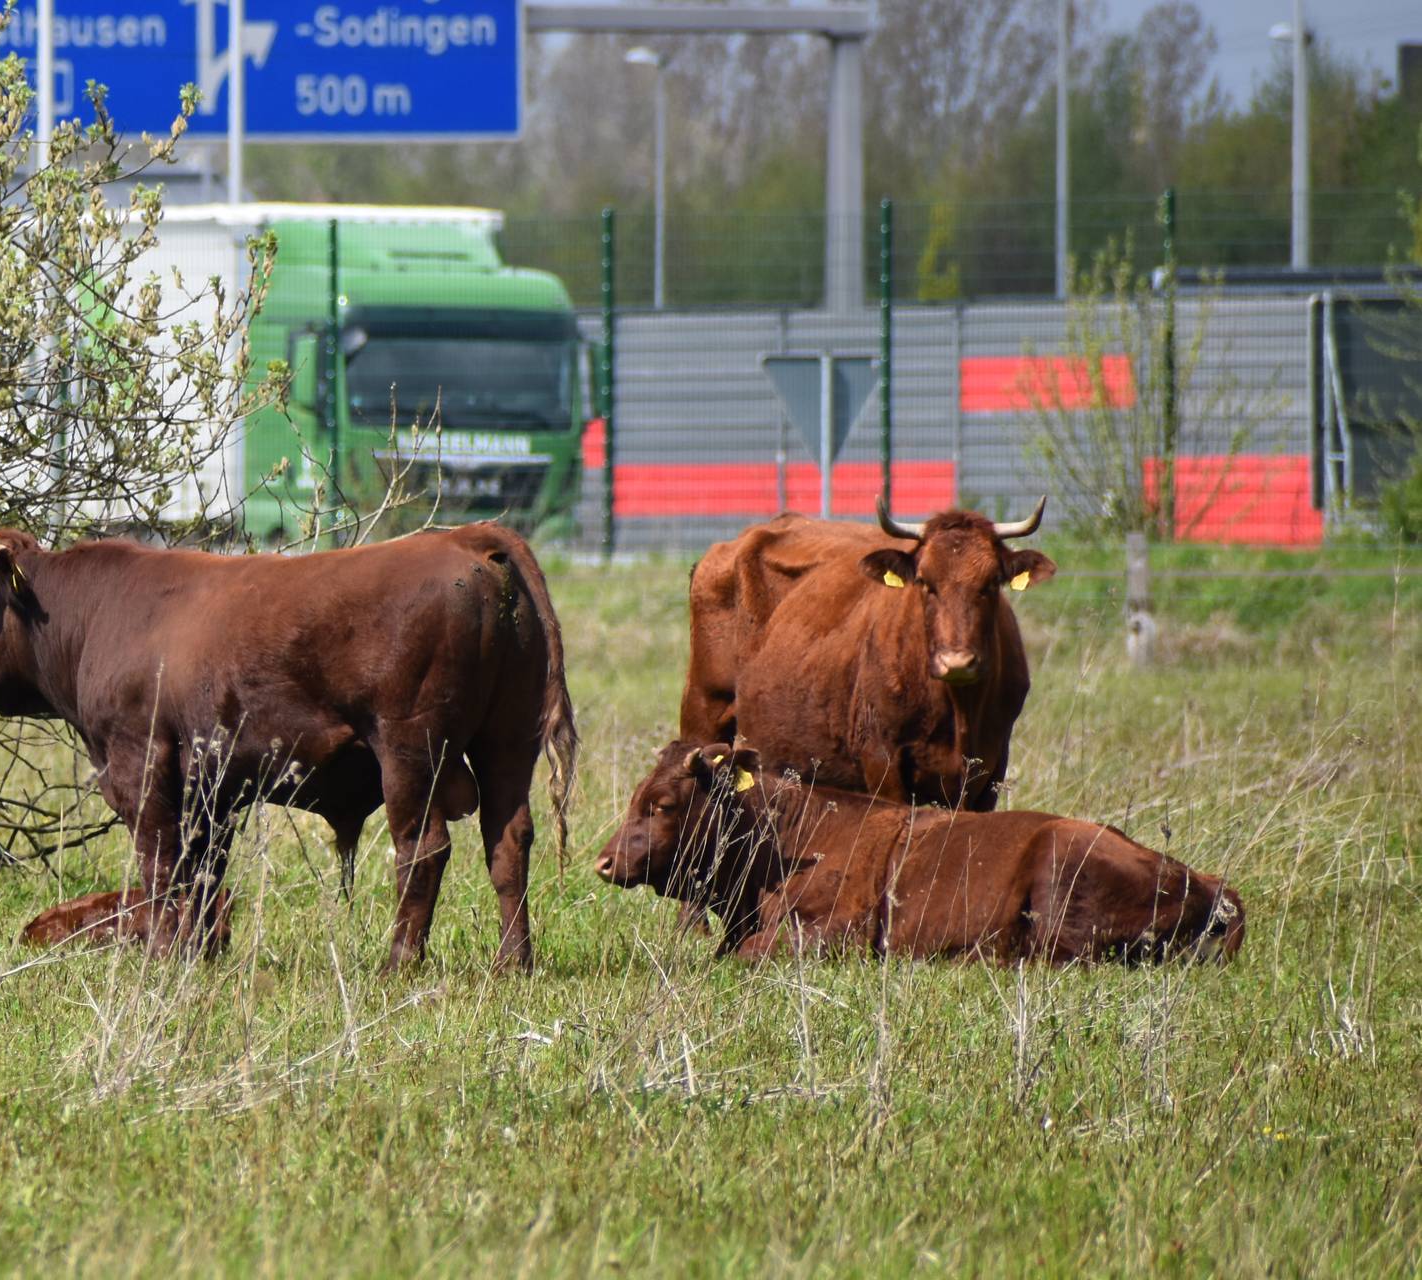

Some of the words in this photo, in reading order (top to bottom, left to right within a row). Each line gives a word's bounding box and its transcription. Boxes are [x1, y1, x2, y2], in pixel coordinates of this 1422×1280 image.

[294, 5, 497, 55] -Sodingen
[295, 73, 367, 116] 500
[373, 83, 412, 116] m
